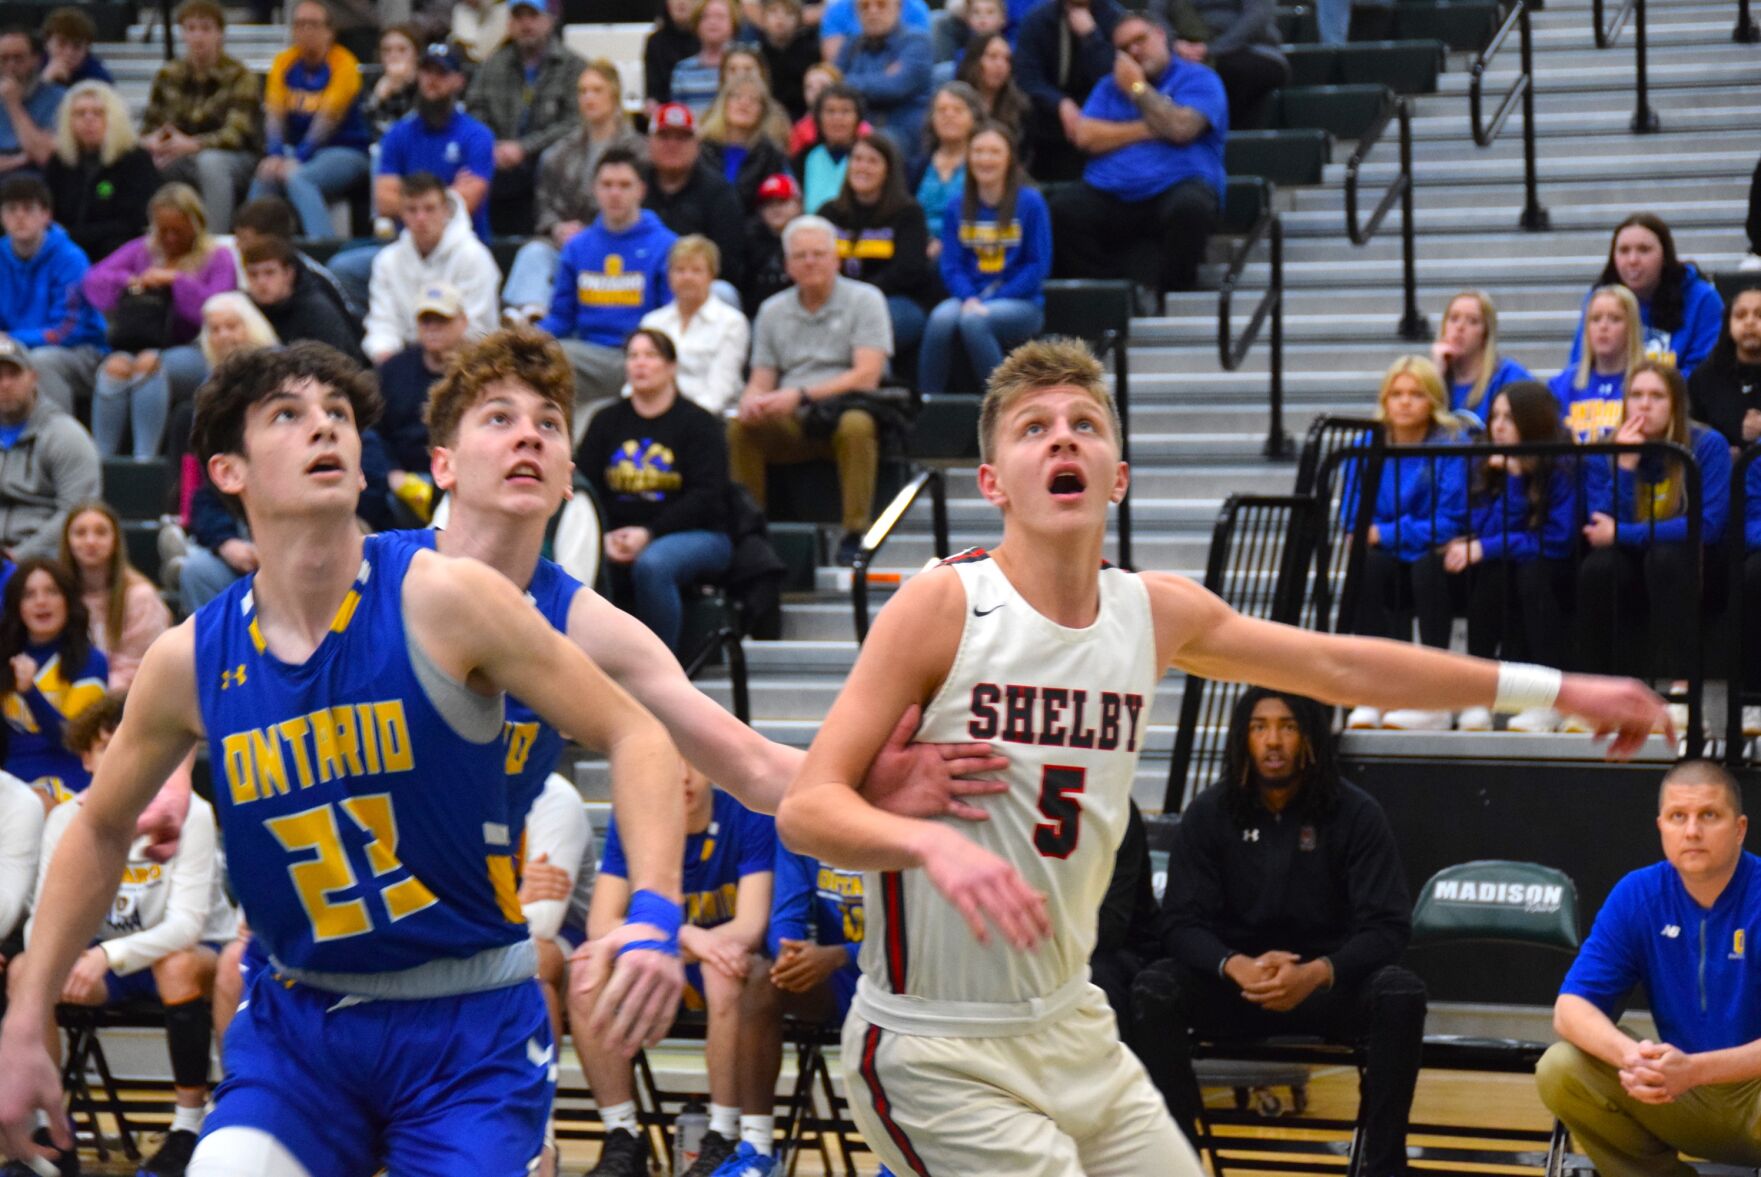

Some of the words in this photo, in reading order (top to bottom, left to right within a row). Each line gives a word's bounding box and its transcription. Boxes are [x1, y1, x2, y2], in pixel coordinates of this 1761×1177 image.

[221, 698, 415, 806] ONTARIO
[968, 683, 1143, 752] SHELBY
[1033, 764, 1088, 860] 5
[1434, 879, 1564, 905] MADISON
